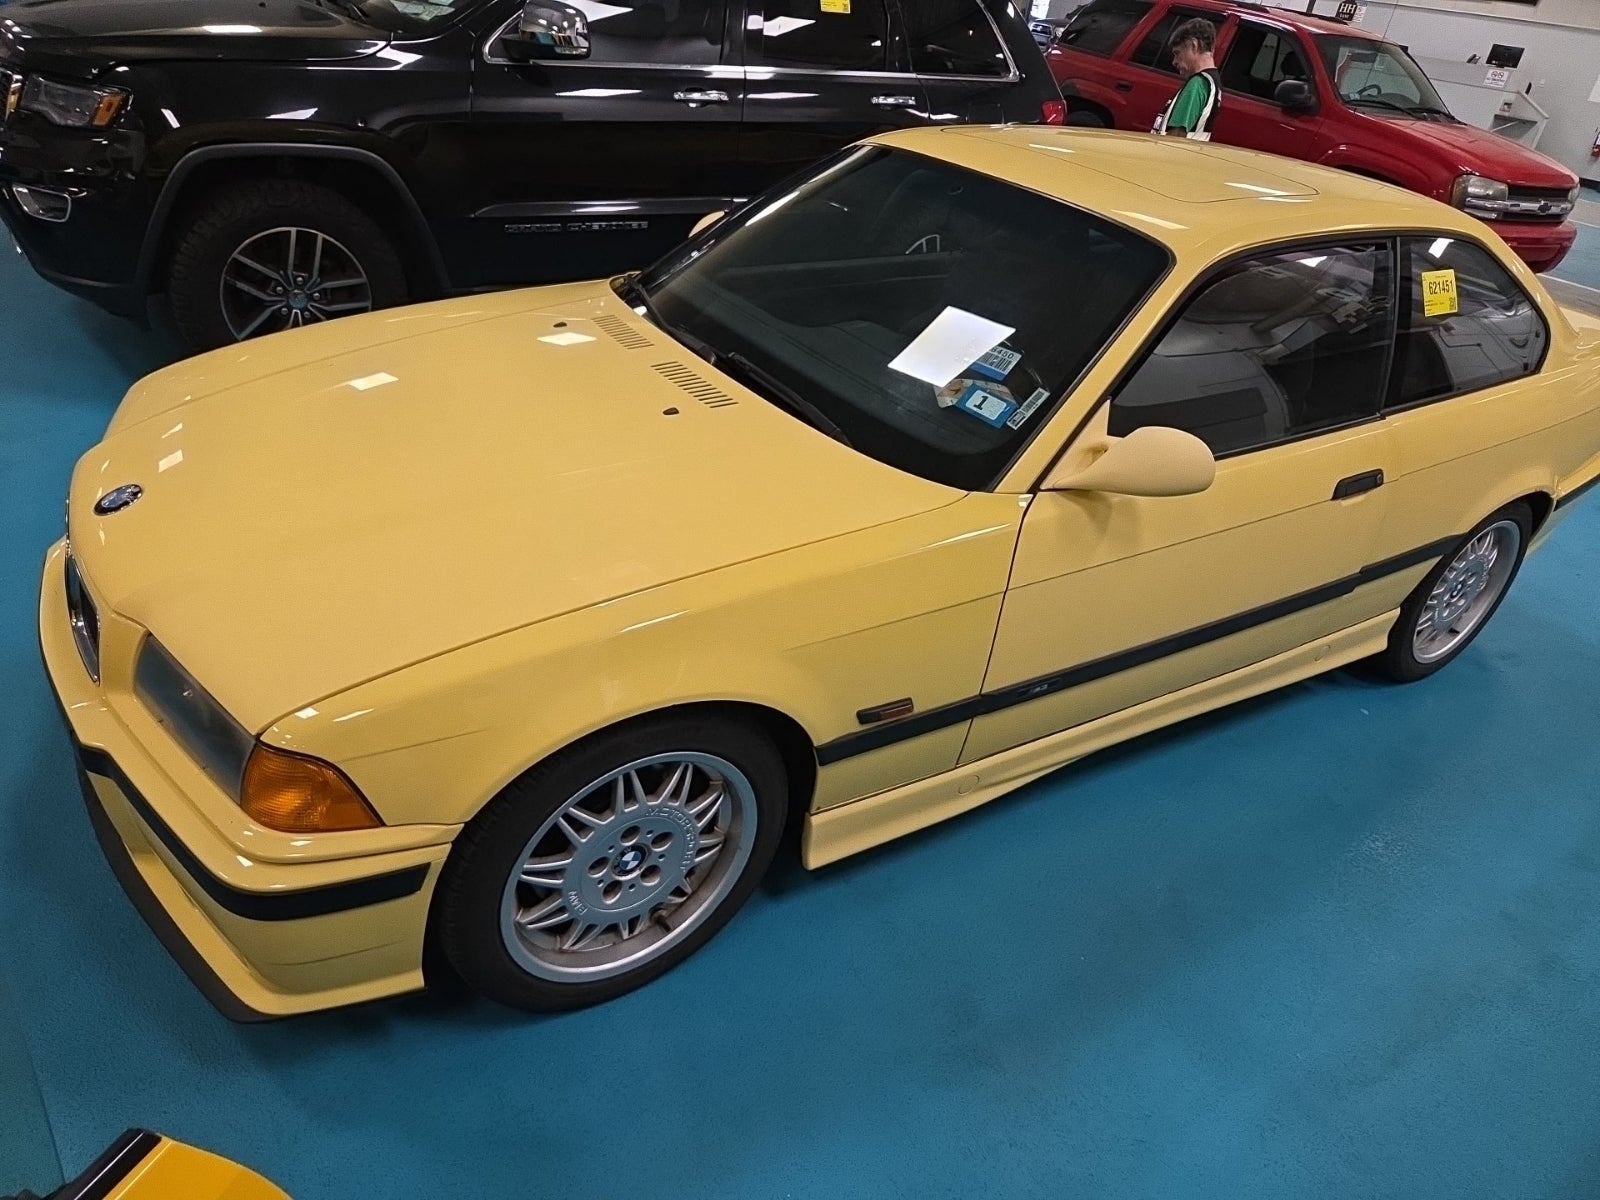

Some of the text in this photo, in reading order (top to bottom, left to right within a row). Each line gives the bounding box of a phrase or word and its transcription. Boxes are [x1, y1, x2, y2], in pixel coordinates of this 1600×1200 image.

[1339, 3, 1356, 13] HH
[504, 221, 648, 232] GRAND CHEROKEE
[1428, 280, 1453, 294] 621451
[973, 395, 989, 411] 1
[568, 890, 589, 916] BMW
